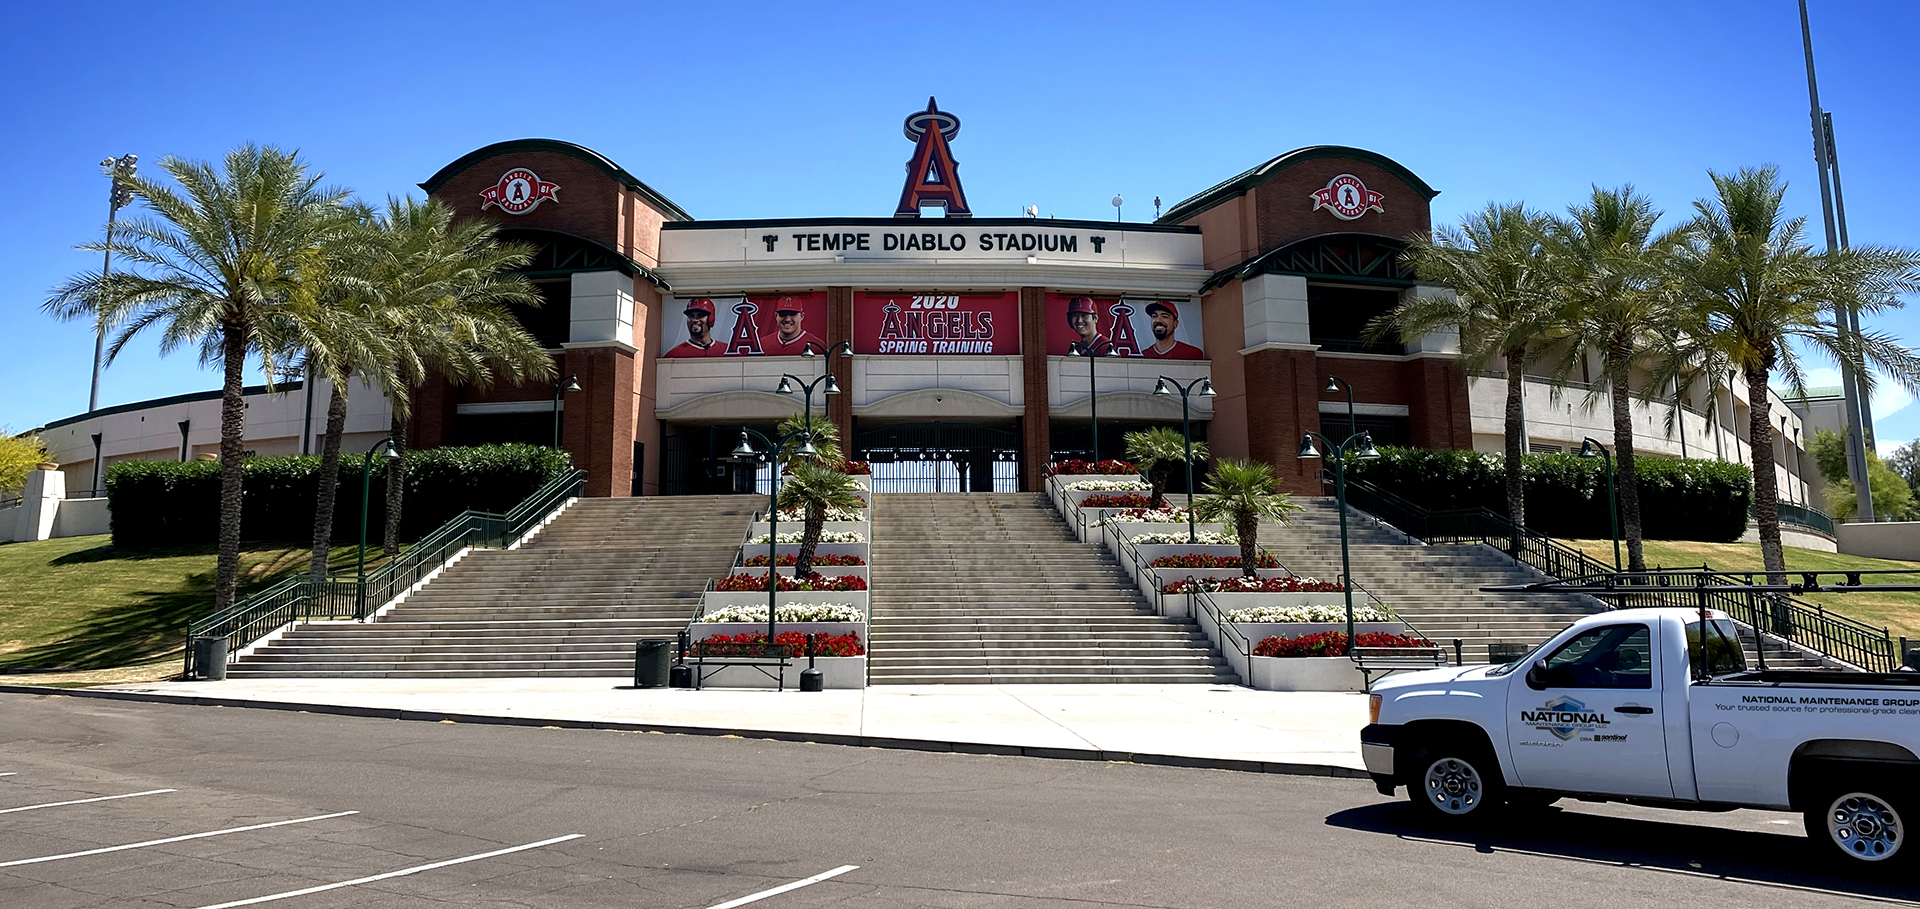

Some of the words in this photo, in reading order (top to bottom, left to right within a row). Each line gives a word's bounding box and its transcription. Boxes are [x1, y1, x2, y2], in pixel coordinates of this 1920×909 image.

[505, 172, 532, 184] ANGELS
[1335, 178, 1360, 188] ANGELS
[488, 190, 497, 199] 19
[541, 185, 549, 193] 61
[501, 196, 535, 210] BASEBALL
[1334, 202, 1364, 215] BASEBALL
[793, 233, 870, 251] TEMPE
[883, 233, 966, 251] DIABLO
[979, 233, 1078, 253] STADIUM
[910, 294, 960, 309] 2020
[724, 297, 764, 355] A
[879, 299, 994, 340] ANGELS
[1109, 299, 1144, 357] A
[879, 341, 928, 354] SPRING
[932, 341, 993, 354] TRAINING
[1742, 696, 1796, 704] NATIONAL
[1799, 697, 1880, 705] MAINTENANCE
[1715, 703, 1735, 711] Your
[1804, 705, 1817, 713] for
[1820, 706, 1896, 715] professional-grade
[1521, 711, 1611, 724] NATIONAL
